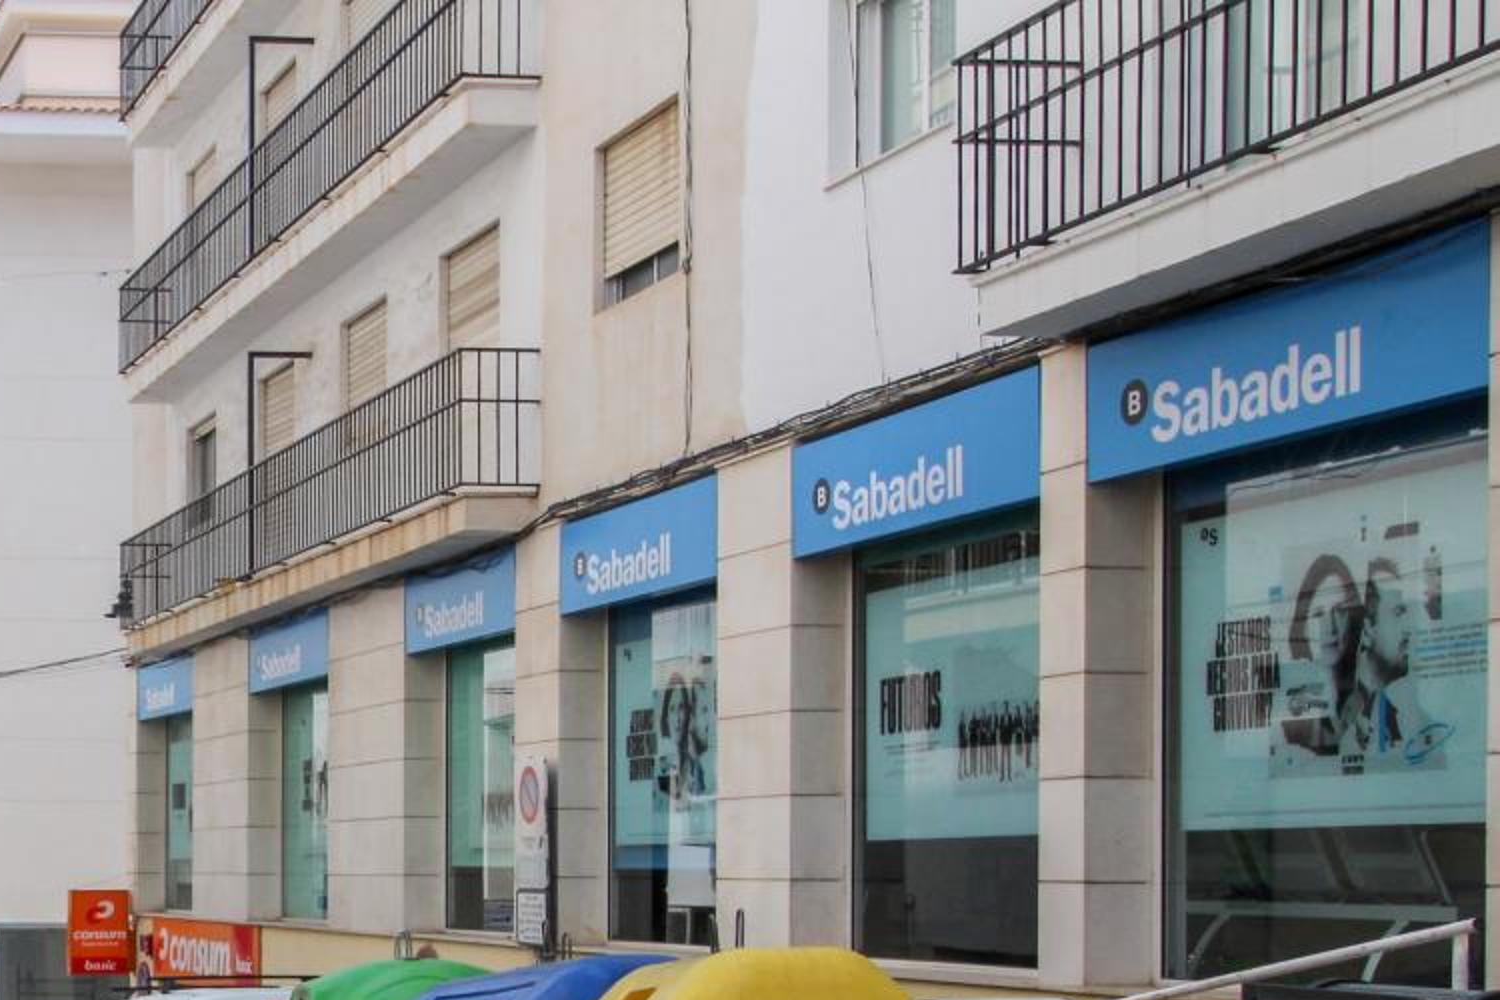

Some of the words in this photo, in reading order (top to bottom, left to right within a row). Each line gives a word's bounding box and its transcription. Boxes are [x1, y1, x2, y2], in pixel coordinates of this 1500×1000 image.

[1151, 325, 1362, 443] Sabadell
[831, 444, 964, 531] Sabadell
[586, 532, 671, 595] Sabadell
[424, 591, 485, 639] Sabadell
[73, 930, 128, 941] consum
[170, 934, 231, 976] consum
